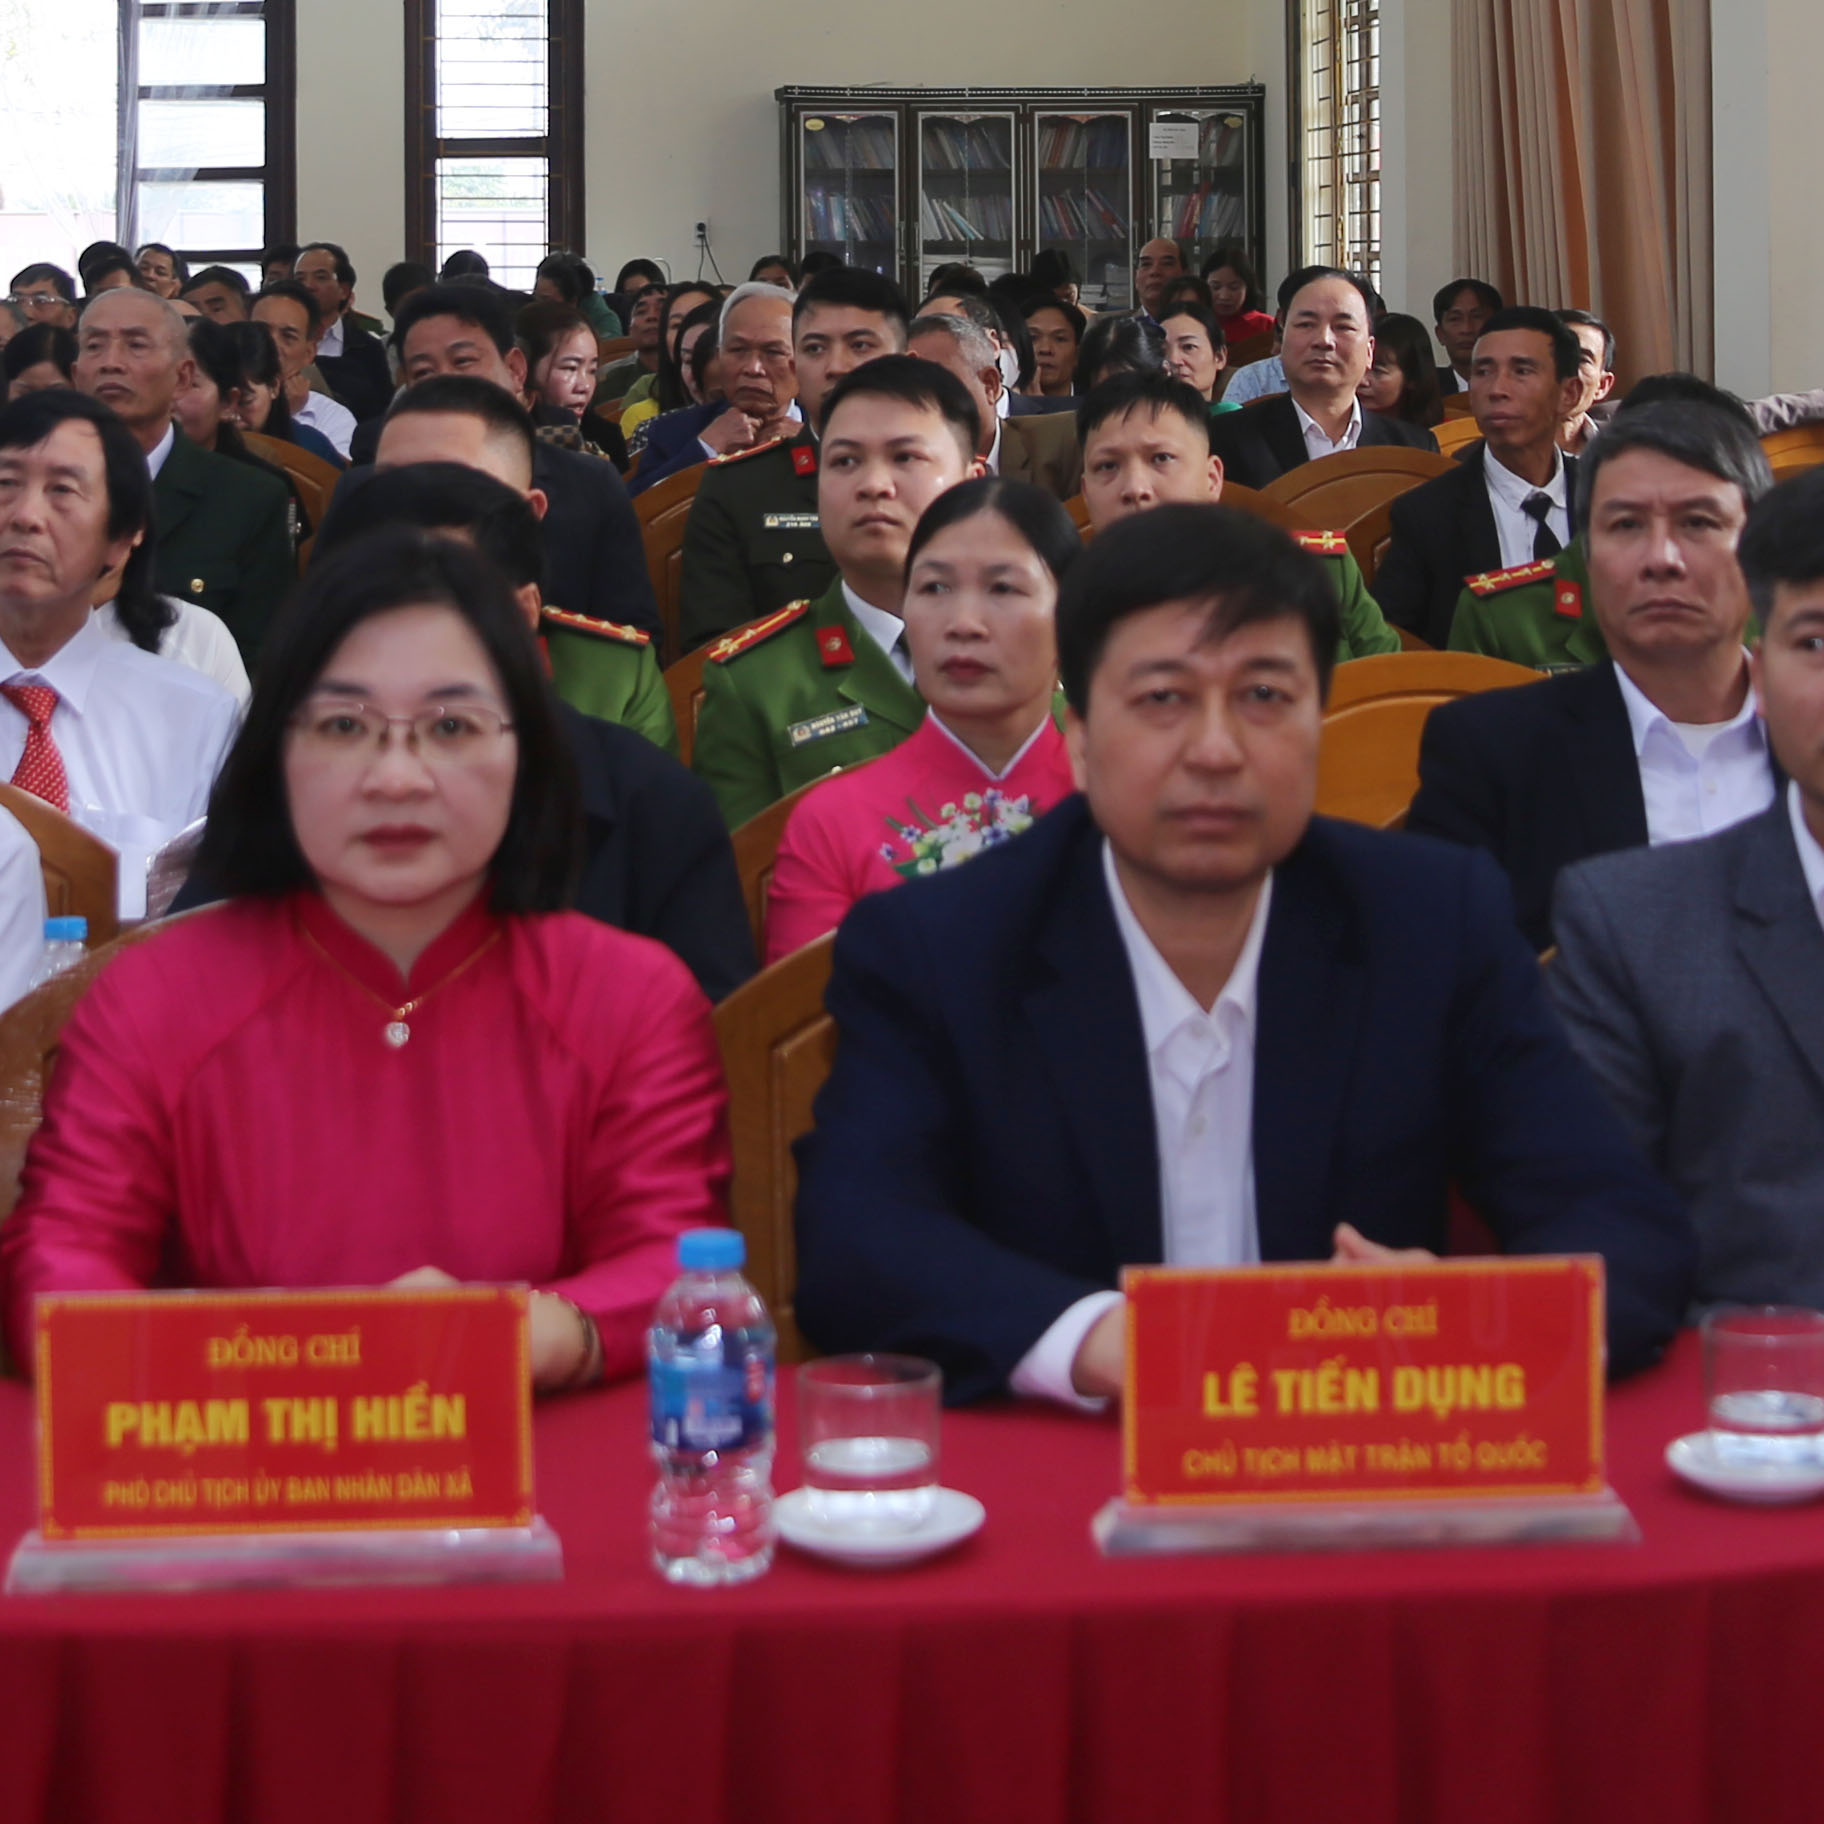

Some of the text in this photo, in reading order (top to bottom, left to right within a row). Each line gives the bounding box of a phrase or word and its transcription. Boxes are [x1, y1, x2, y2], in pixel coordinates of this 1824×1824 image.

[1203, 1355, 1526, 1420] LÊ TIẾN DỤNG
[105, 1398, 250, 1455] PHẠM
[262, 1396, 339, 1453] THỊ
